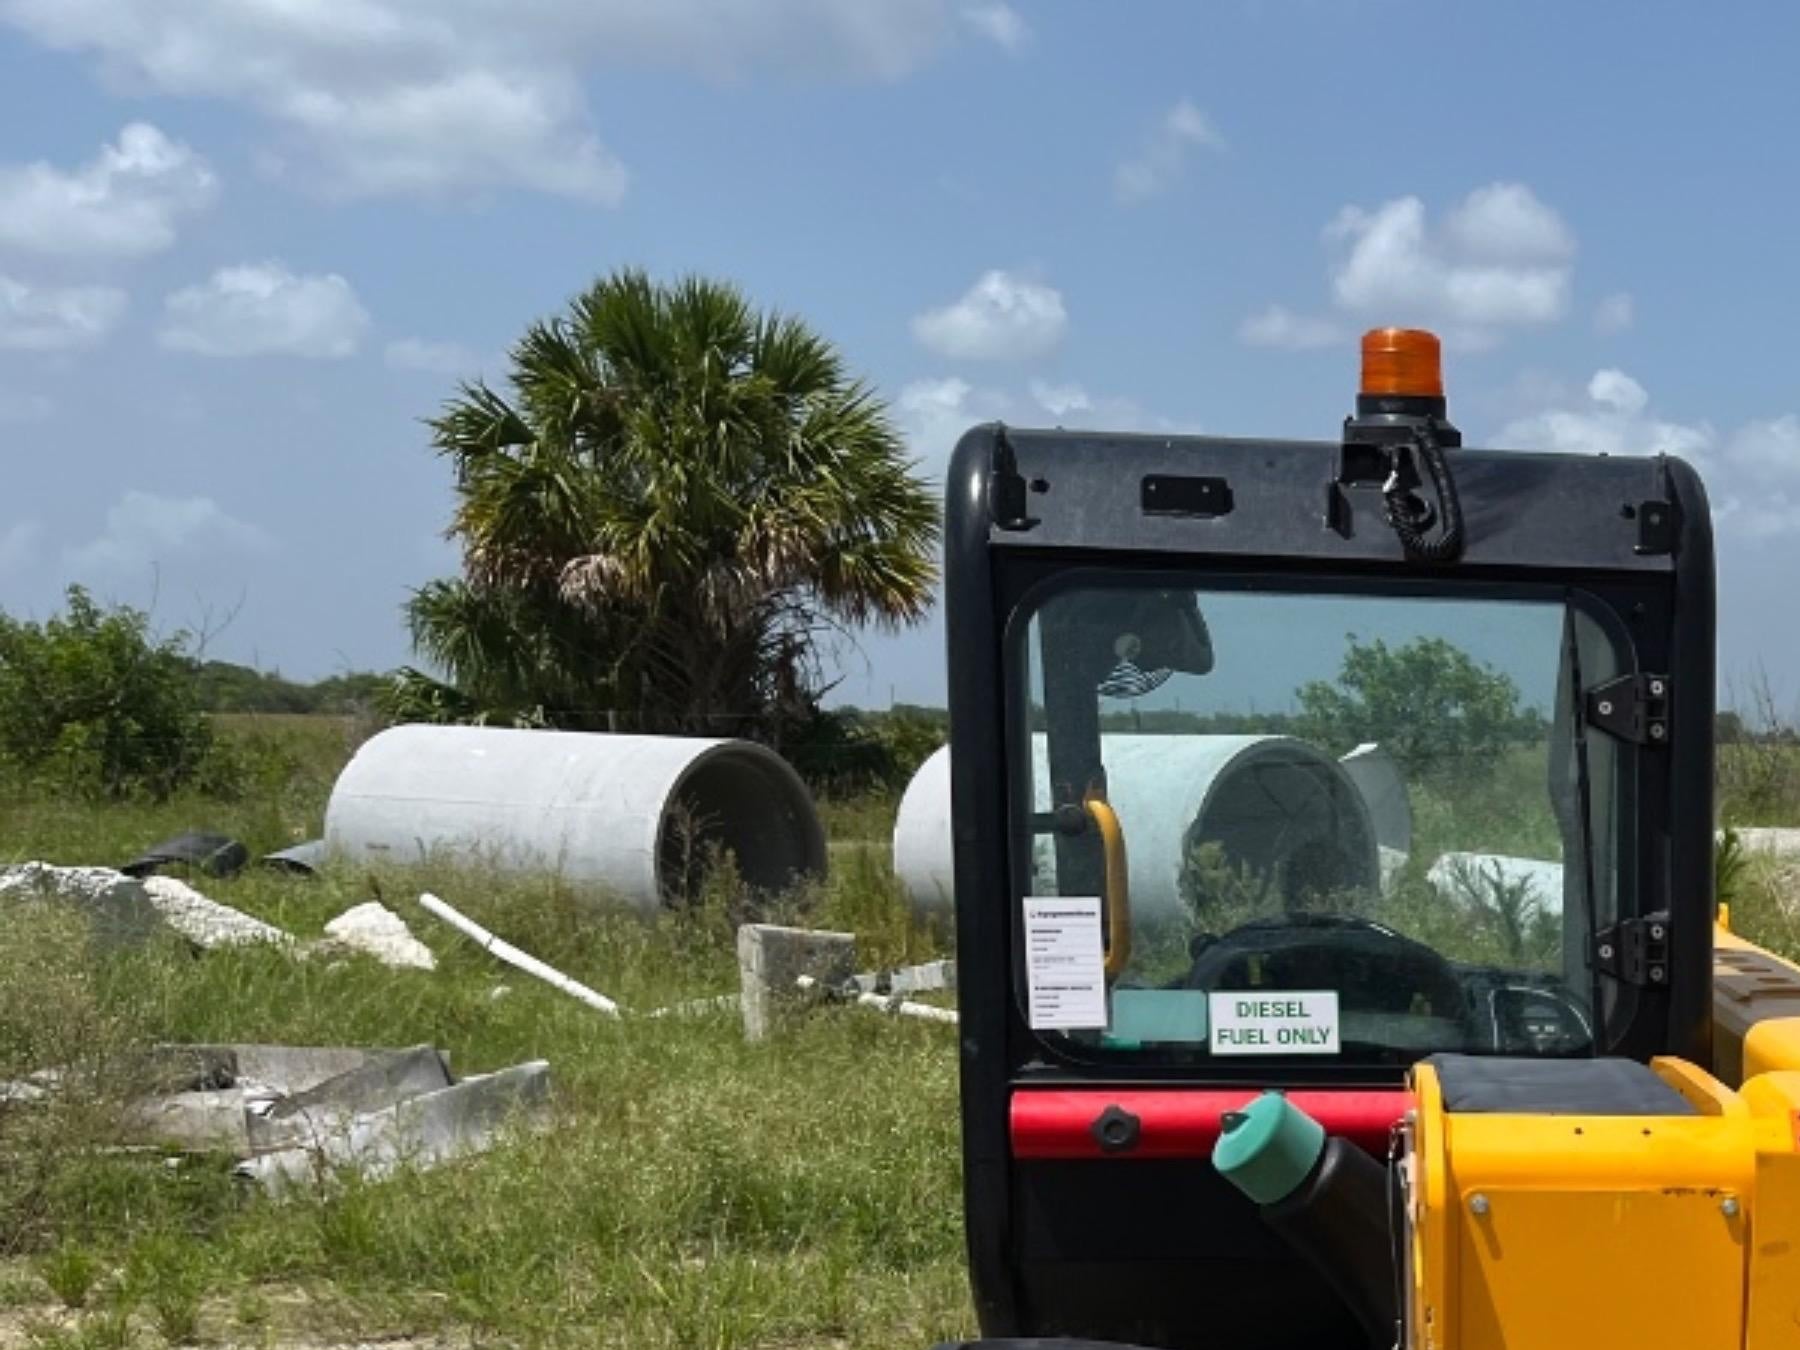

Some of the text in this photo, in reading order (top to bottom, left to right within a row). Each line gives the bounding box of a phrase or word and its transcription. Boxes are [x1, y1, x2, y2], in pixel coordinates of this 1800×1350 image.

[1236, 1000, 1310, 1018] DIESEL
[1217, 1026, 1331, 1045] FUEL ONLY
